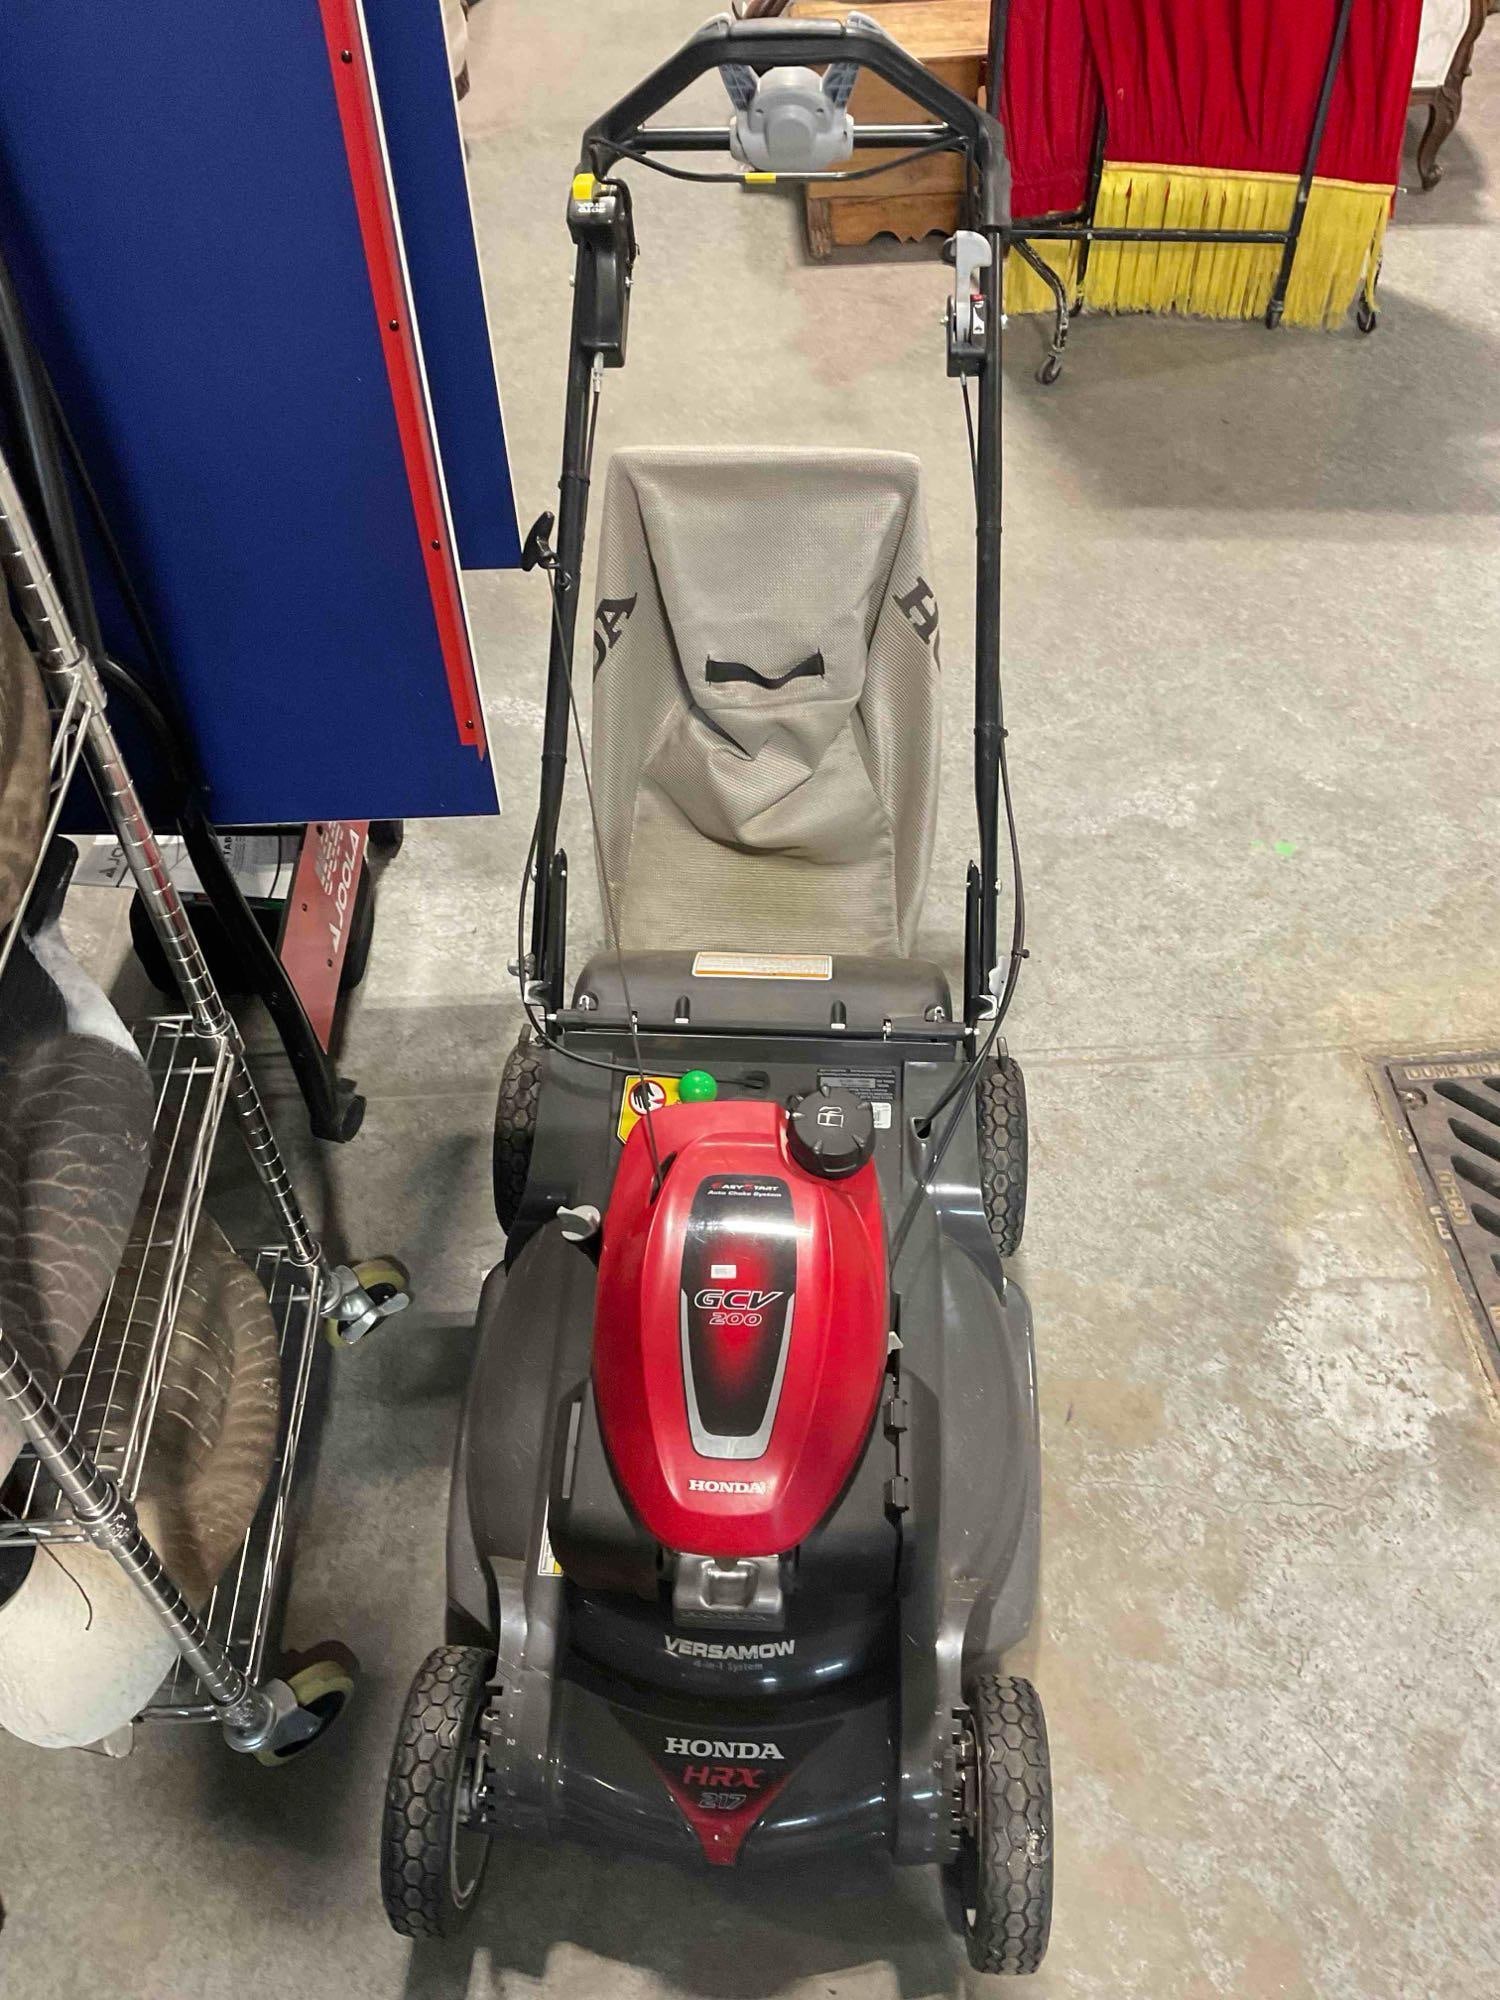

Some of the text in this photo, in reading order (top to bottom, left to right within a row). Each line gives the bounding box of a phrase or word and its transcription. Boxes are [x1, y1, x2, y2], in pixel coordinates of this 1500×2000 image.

[694, 1289, 784, 1311] GCV
[709, 1312, 762, 1327] 200
[688, 1479, 766, 1495] HONDA
[664, 1634, 796, 1661] VERSAMOW
[727, 1661, 764, 1673] System
[664, 1736, 785, 1760] HONDA
[683, 1764, 766, 1789] HRX
[698, 1792, 747, 1811] 217
